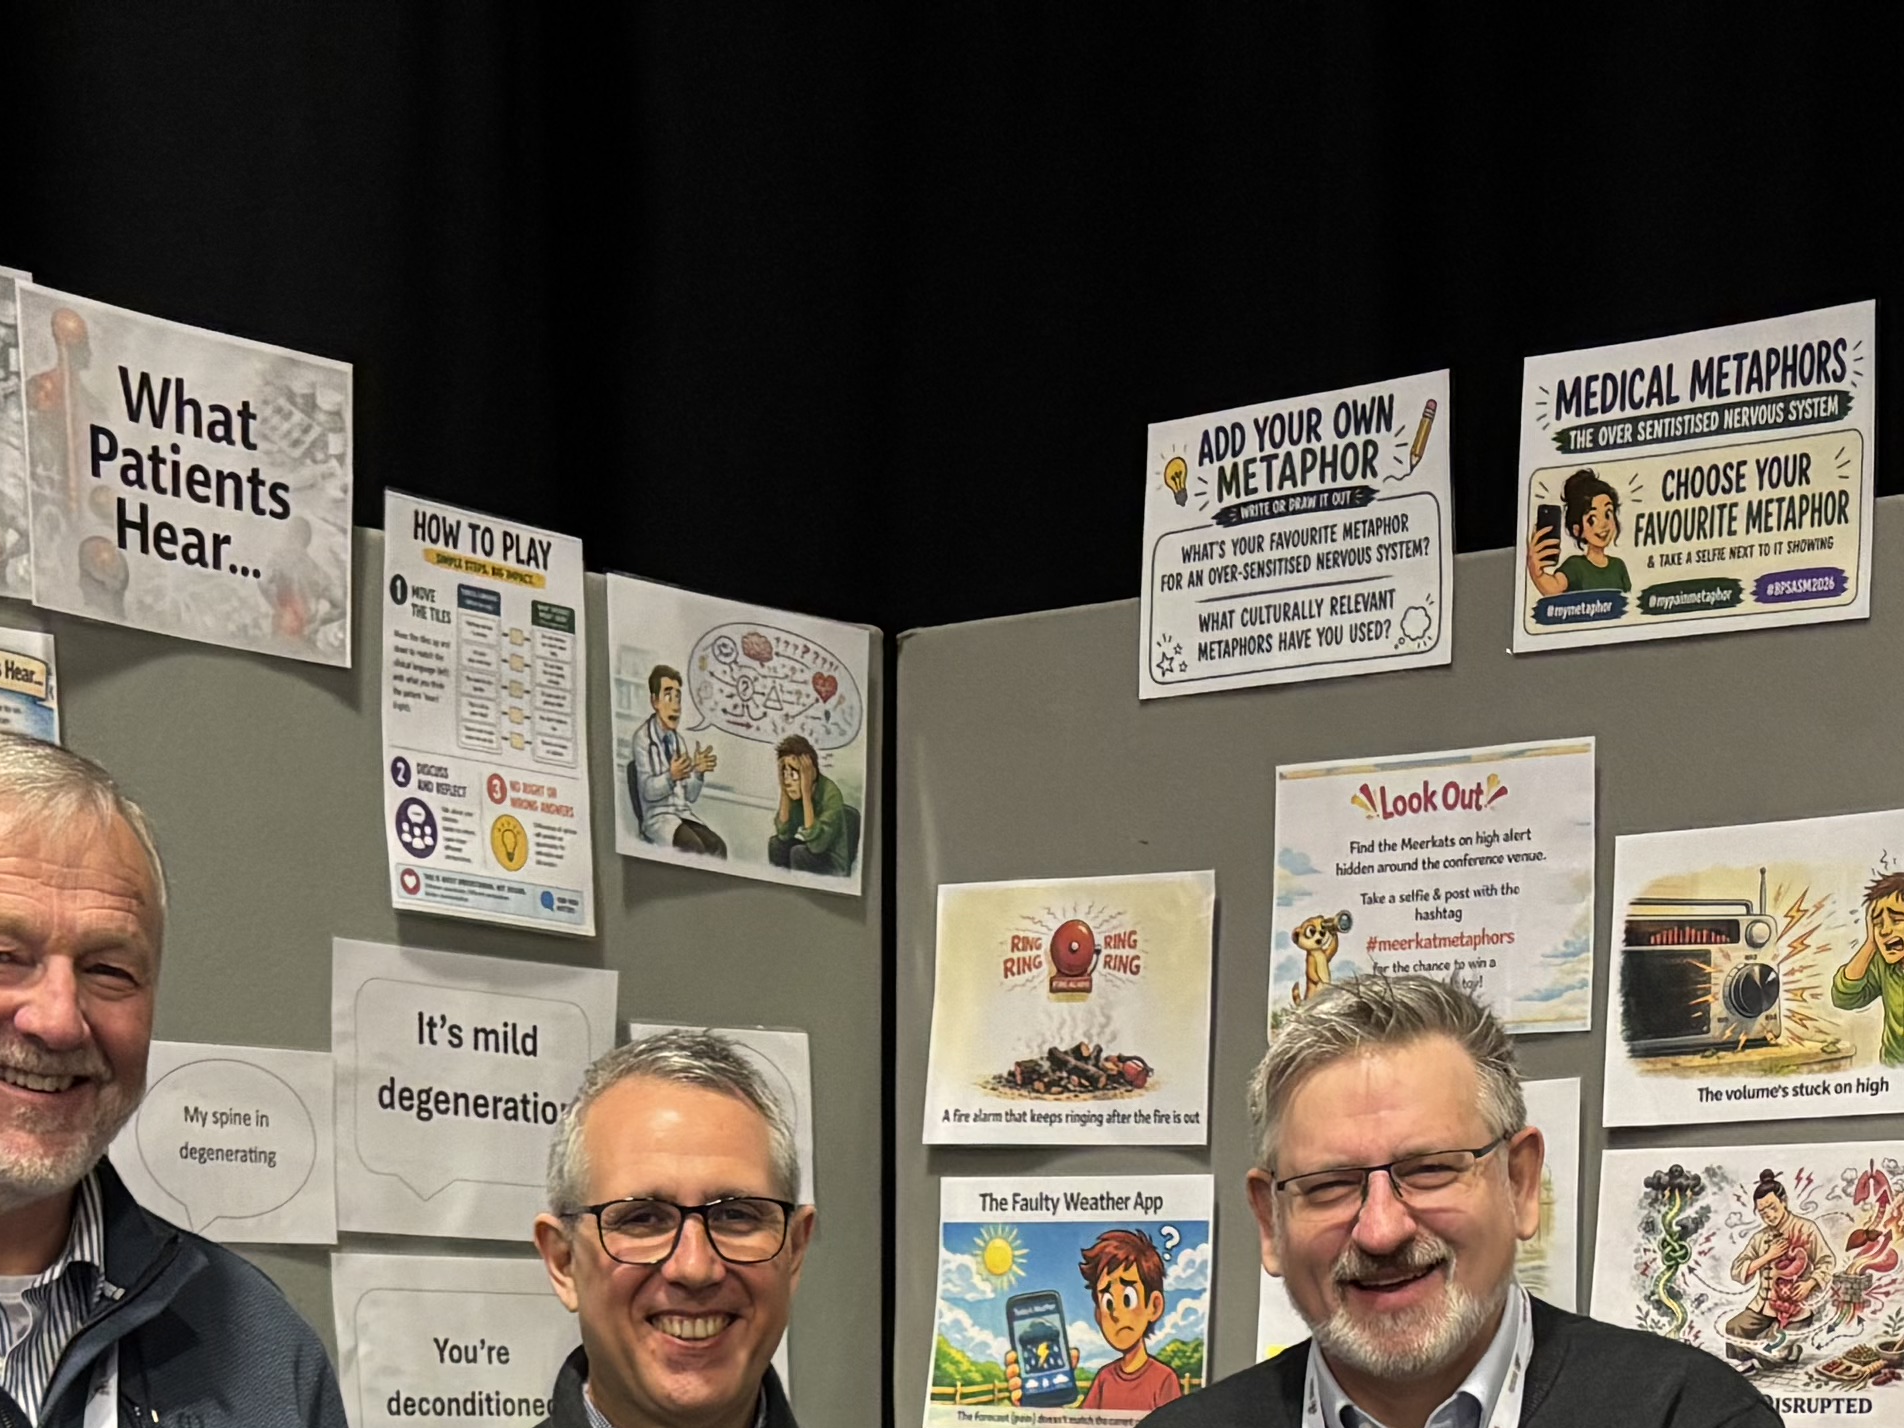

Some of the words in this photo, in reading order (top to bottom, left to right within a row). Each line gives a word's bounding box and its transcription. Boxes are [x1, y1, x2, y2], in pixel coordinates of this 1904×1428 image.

[1556, 362, 1680, 421] MEDICAL
[1690, 337, 1849, 401] METAPHORS
[118, 366, 257, 454] What
[1570, 428, 1594, 449] THE
[1599, 423, 1632, 446] OVER
[1637, 412, 1718, 441] SENTISTISED
[1724, 403, 1784, 429] NERVOUS
[1788, 395, 1838, 420] SYSTEM
[1198, 422, 1245, 467] ADD
[1254, 408, 1322, 449] YOUR
[1333, 394, 1394, 438] OWN
[90, 414, 290, 520] Patients
[1217, 438, 1379, 503] METAPHOR
[1662, 460, 1747, 501] CHOOSE
[1756, 453, 1811, 491] YOUR
[117, 486, 266, 578] Hear...
[1182, 540, 1225, 563] WHAT'S
[1231, 534, 1264, 556] YOUR
[1270, 524, 1337, 551] FAVOURITE
[1343, 513, 1408, 541] METAPHOR
[1635, 502, 1738, 547] FAVOURITE
[1746, 490, 1849, 535] METAPHOR
[414, 510, 461, 549] HOW
[468, 523, 494, 557] TO
[503, 531, 551, 570] PLAY
[1161, 572, 1182, 592] FOR
[1188, 570, 1203, 588] AN
[1209, 555, 1311, 585] OVER-SENSITISED
[1317, 546, 1371, 570] NERVOUS
[1377, 537, 1430, 562] SYSTEM?
[1380, 780, 1437, 820] Look
[1350, 840, 1374, 854] Find
[1378, 839, 1397, 852] the
[1401, 835, 1456, 850] Meerkats
[1460, 832, 1473, 848] on
[1476, 830, 1499, 848] high
[1503, 828, 1531, 842] alert
[1415, 906, 1462, 922] hashtag
[1011, 935, 1041, 953] RING
[1104, 930, 1137, 949] RING
[1366, 927, 1514, 952] #meerkatmetaphors
[1003, 955, 1042, 979] RING
[1104, 954, 1140, 975] RING
[418, 1011, 463, 1048] It's
[474, 1022, 537, 1057] mild
[1697, 1087, 1723, 1102] The
[1726, 1085, 1789, 1100] volume's
[1792, 1080, 1830, 1097] stuck
[1834, 1083, 1852, 1094] on
[1856, 1077, 1889, 1096] high
[184, 1106, 208, 1127] My
[212, 1108, 251, 1128] spine
[256, 1110, 269, 1127] in
[942, 1109, 950, 1122] A
[954, 1109, 970, 1122] fire
[973, 1108, 1002, 1122] alarm
[1005, 1109, 1027, 1122] that
[1030, 1109, 1062, 1126] keeps
[1065, 1110, 1103, 1127] ringing
[1106, 1109, 1131, 1124] after
[1134, 1109, 1151, 1124] the
[1153, 1109, 1171, 1124] fire
[1173, 1110, 1181, 1124] is
[1184, 1112, 1200, 1124] out
[179, 1142, 276, 1168] degenerating
[979, 1193, 1008, 1211] The
[1012, 1192, 1060, 1215] Faulty
[1064, 1191, 1130, 1211] Weather
[1133, 1192, 1163, 1215] App
[433, 1338, 509, 1364] You're
